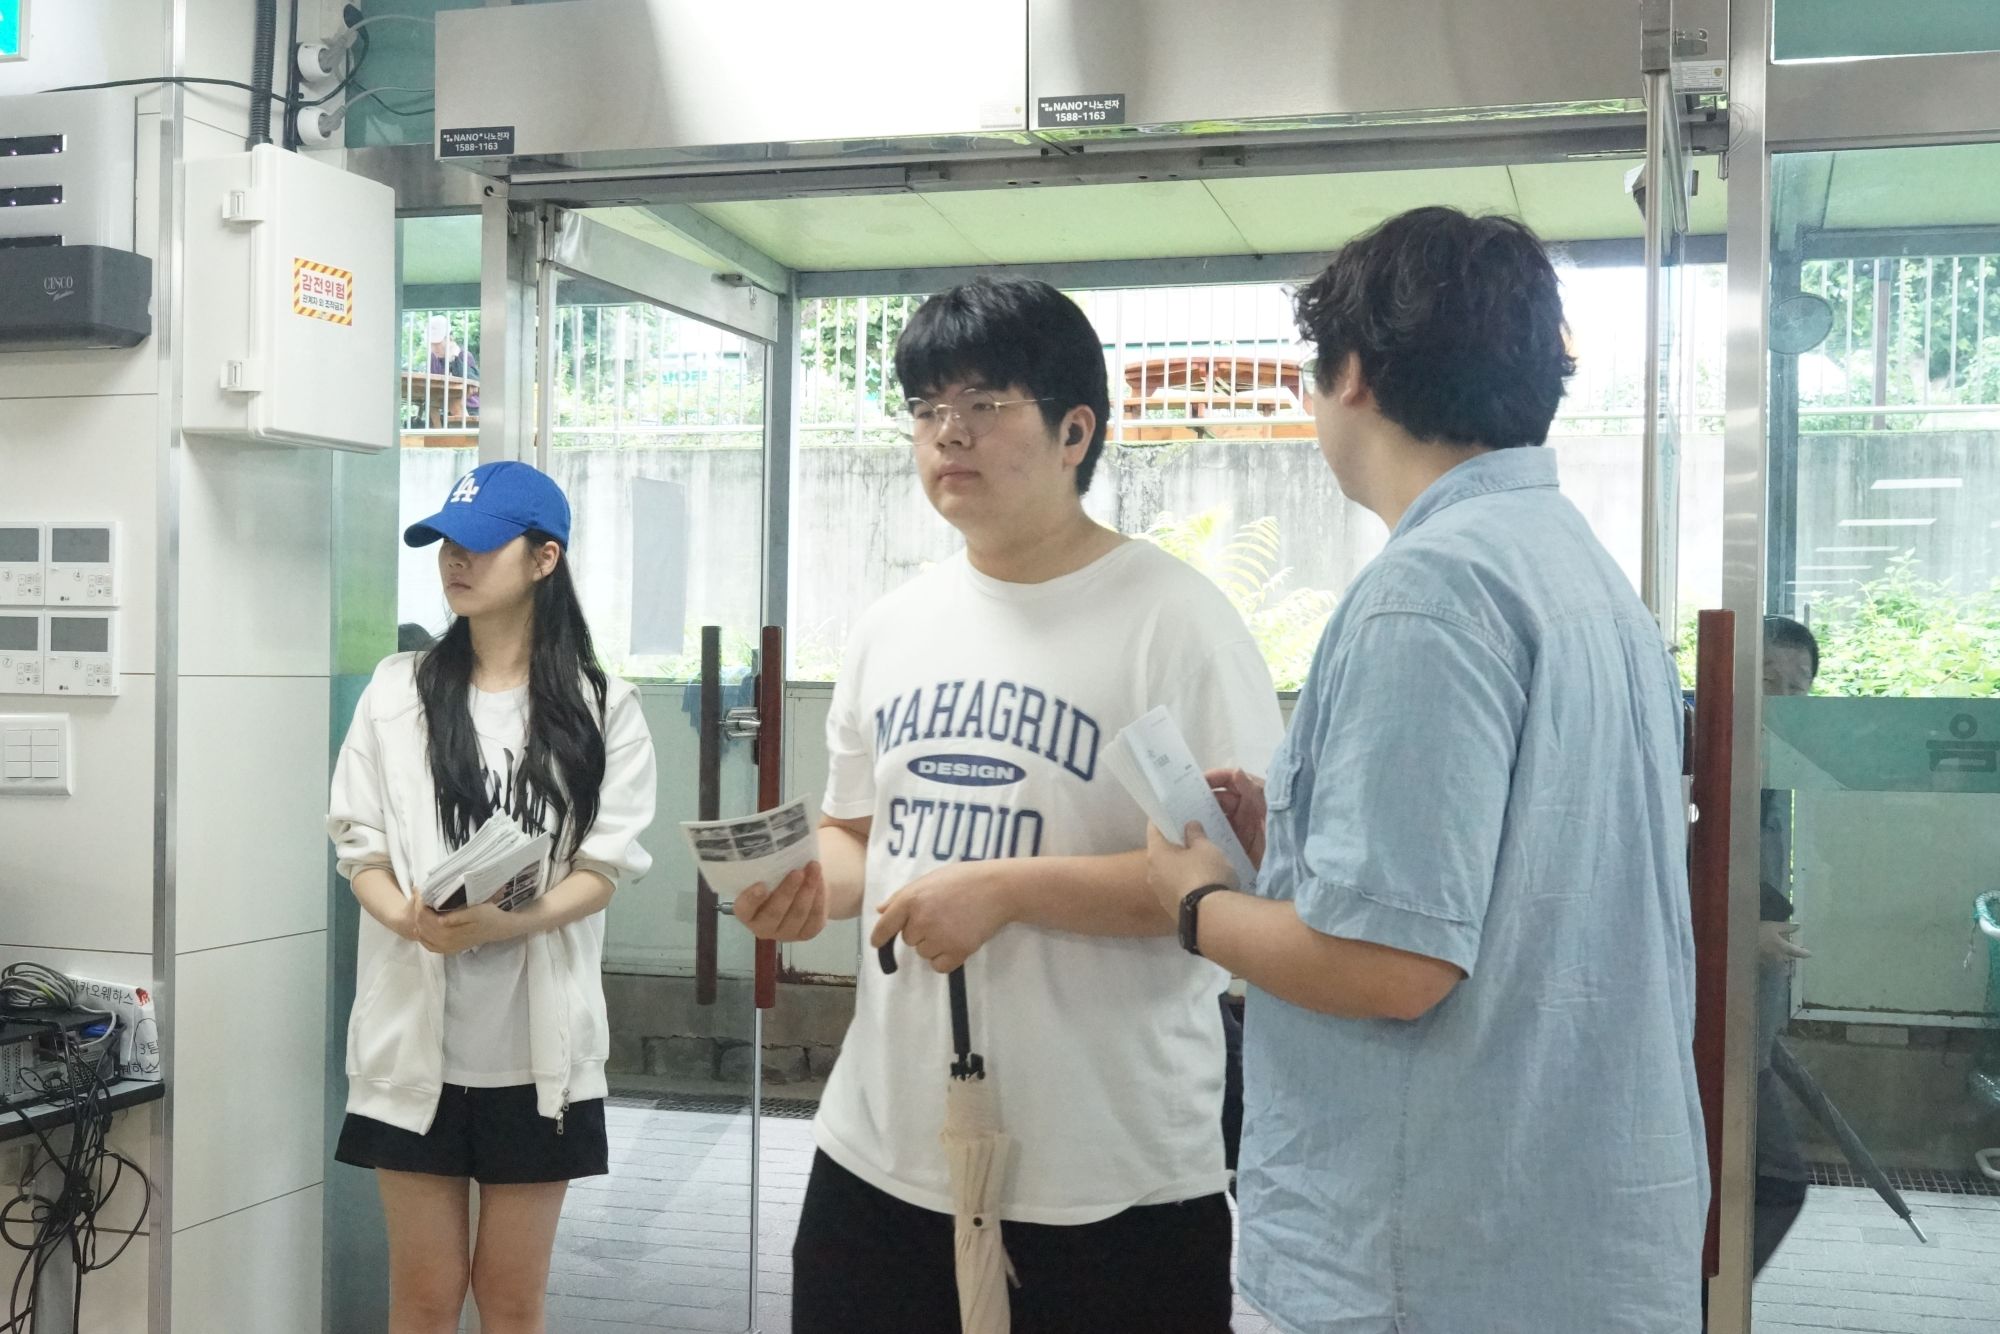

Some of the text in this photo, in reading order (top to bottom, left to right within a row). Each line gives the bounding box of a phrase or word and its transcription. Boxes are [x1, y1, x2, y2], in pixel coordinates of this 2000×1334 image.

[1053, 99, 1120, 111] NANO 나노전자
[1055, 111, 1106, 121] 1588-1163
[453, 131, 510, 142] NANO 나노전자
[455, 142, 498, 152] 1588-1163
[302, 273, 345, 300] 감전위험
[450, 472, 480, 503] LA
[875, 680, 1100, 782] MAHAGRID
[918, 760, 1015, 780] DESIGN
[888, 798, 1044, 862] STUDIO
